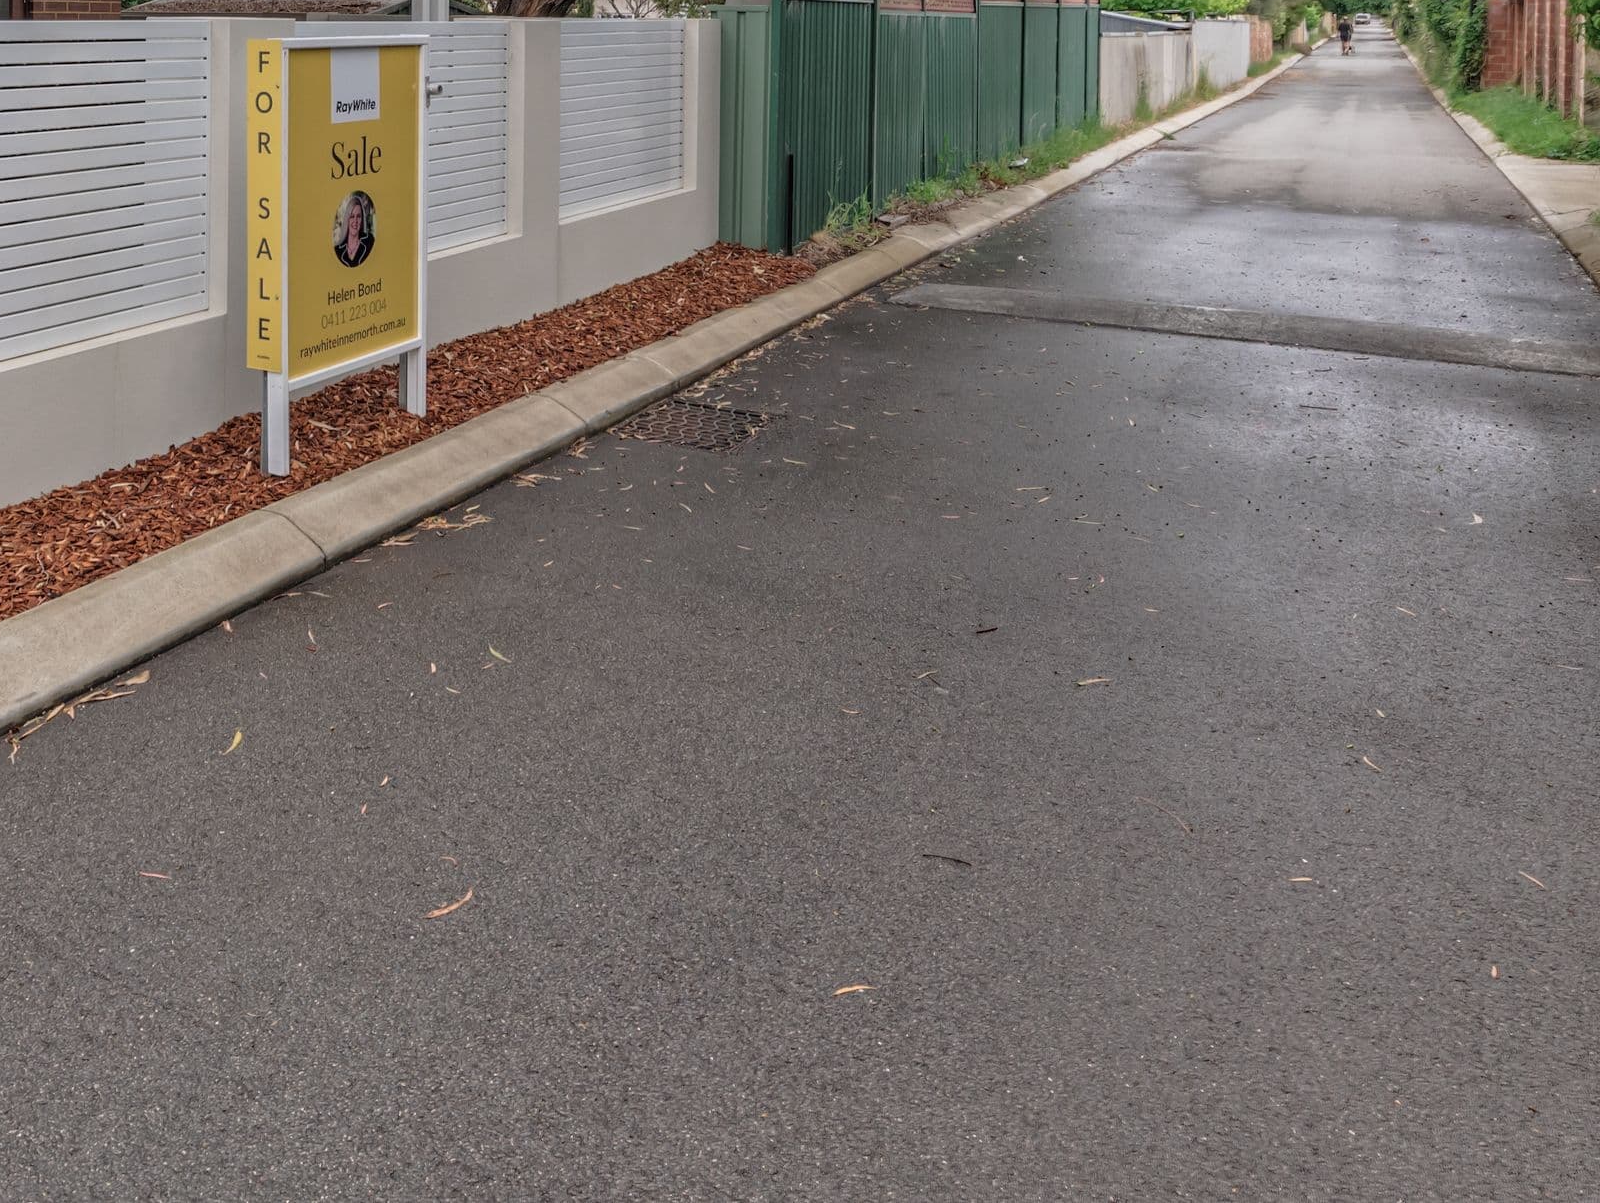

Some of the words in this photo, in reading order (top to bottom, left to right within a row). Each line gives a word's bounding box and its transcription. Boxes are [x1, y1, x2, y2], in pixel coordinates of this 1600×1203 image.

[255, 50, 273, 155] FOR
[331, 136, 382, 180] Sale
[256, 197, 273, 341] SALE
[327, 287, 356, 306] Helen
[358, 278, 382, 297] Bond
[299, 317, 406, 359] raywhiteinnernorth.com.au
[321, 310, 346, 330] 0411
[349, 303, 367, 321] 223
